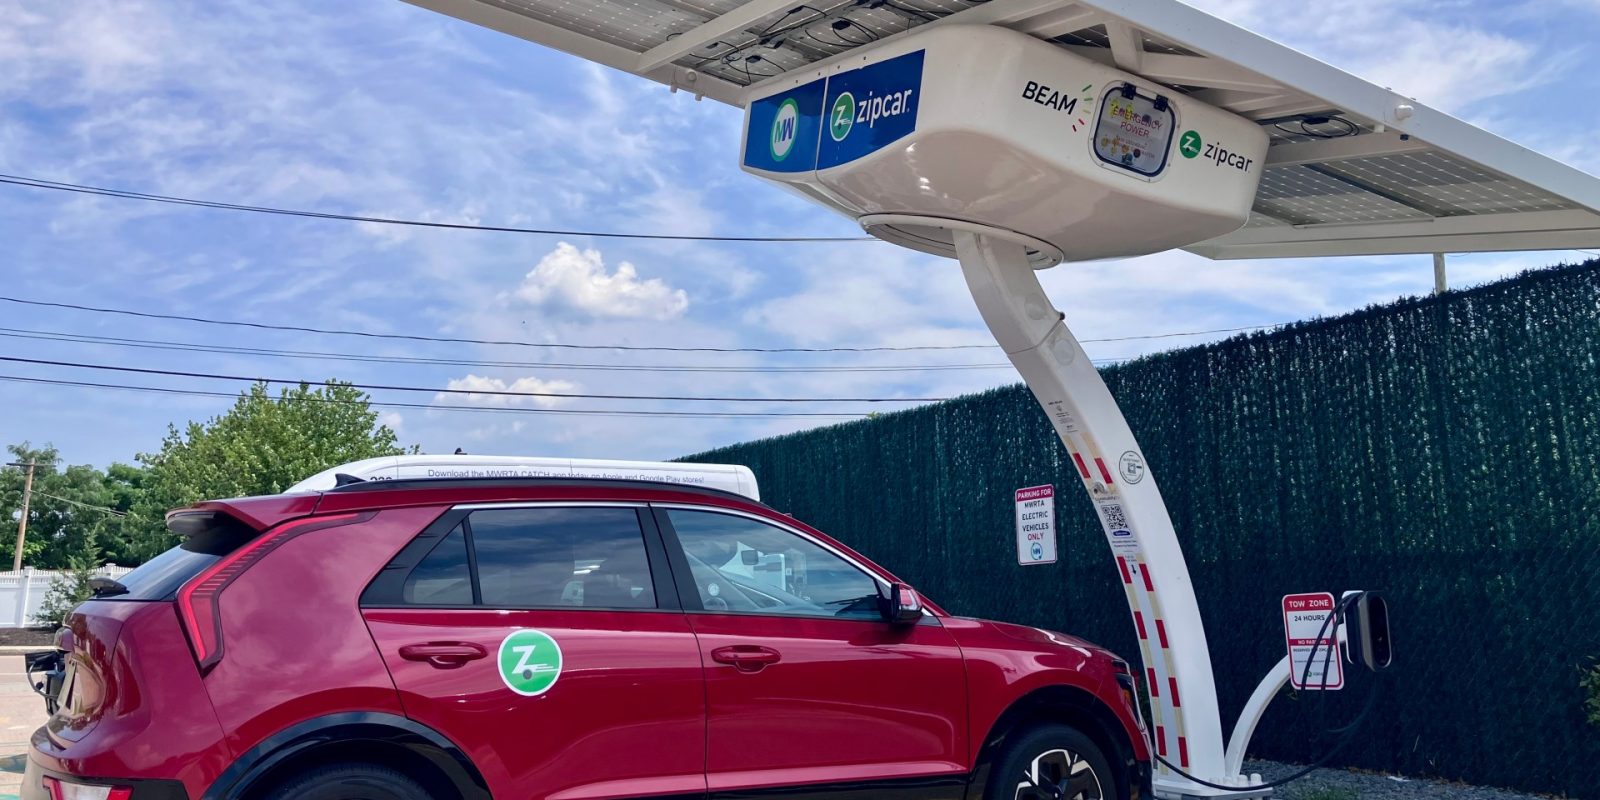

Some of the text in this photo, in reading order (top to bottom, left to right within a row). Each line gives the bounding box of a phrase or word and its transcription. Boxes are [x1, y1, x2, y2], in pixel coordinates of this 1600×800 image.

[1022, 81, 1077, 115] BEAM
[1112, 106, 1162, 131] EMERGENCY
[1120, 121, 1150, 137] POWER
[428, 469, 469, 477] Download
[471, 469, 484, 477] the
[486, 470, 519, 478] MWRTA
[1018, 488, 1052, 499] PARKING FOR
[1024, 500, 1045, 508] MWRTA
[1022, 511, 1048, 520] ELECTRIC
[1022, 523, 1049, 532] VEHICLES
[1027, 532, 1044, 541] ONLY
[1309, 599, 1329, 607] ZONE
